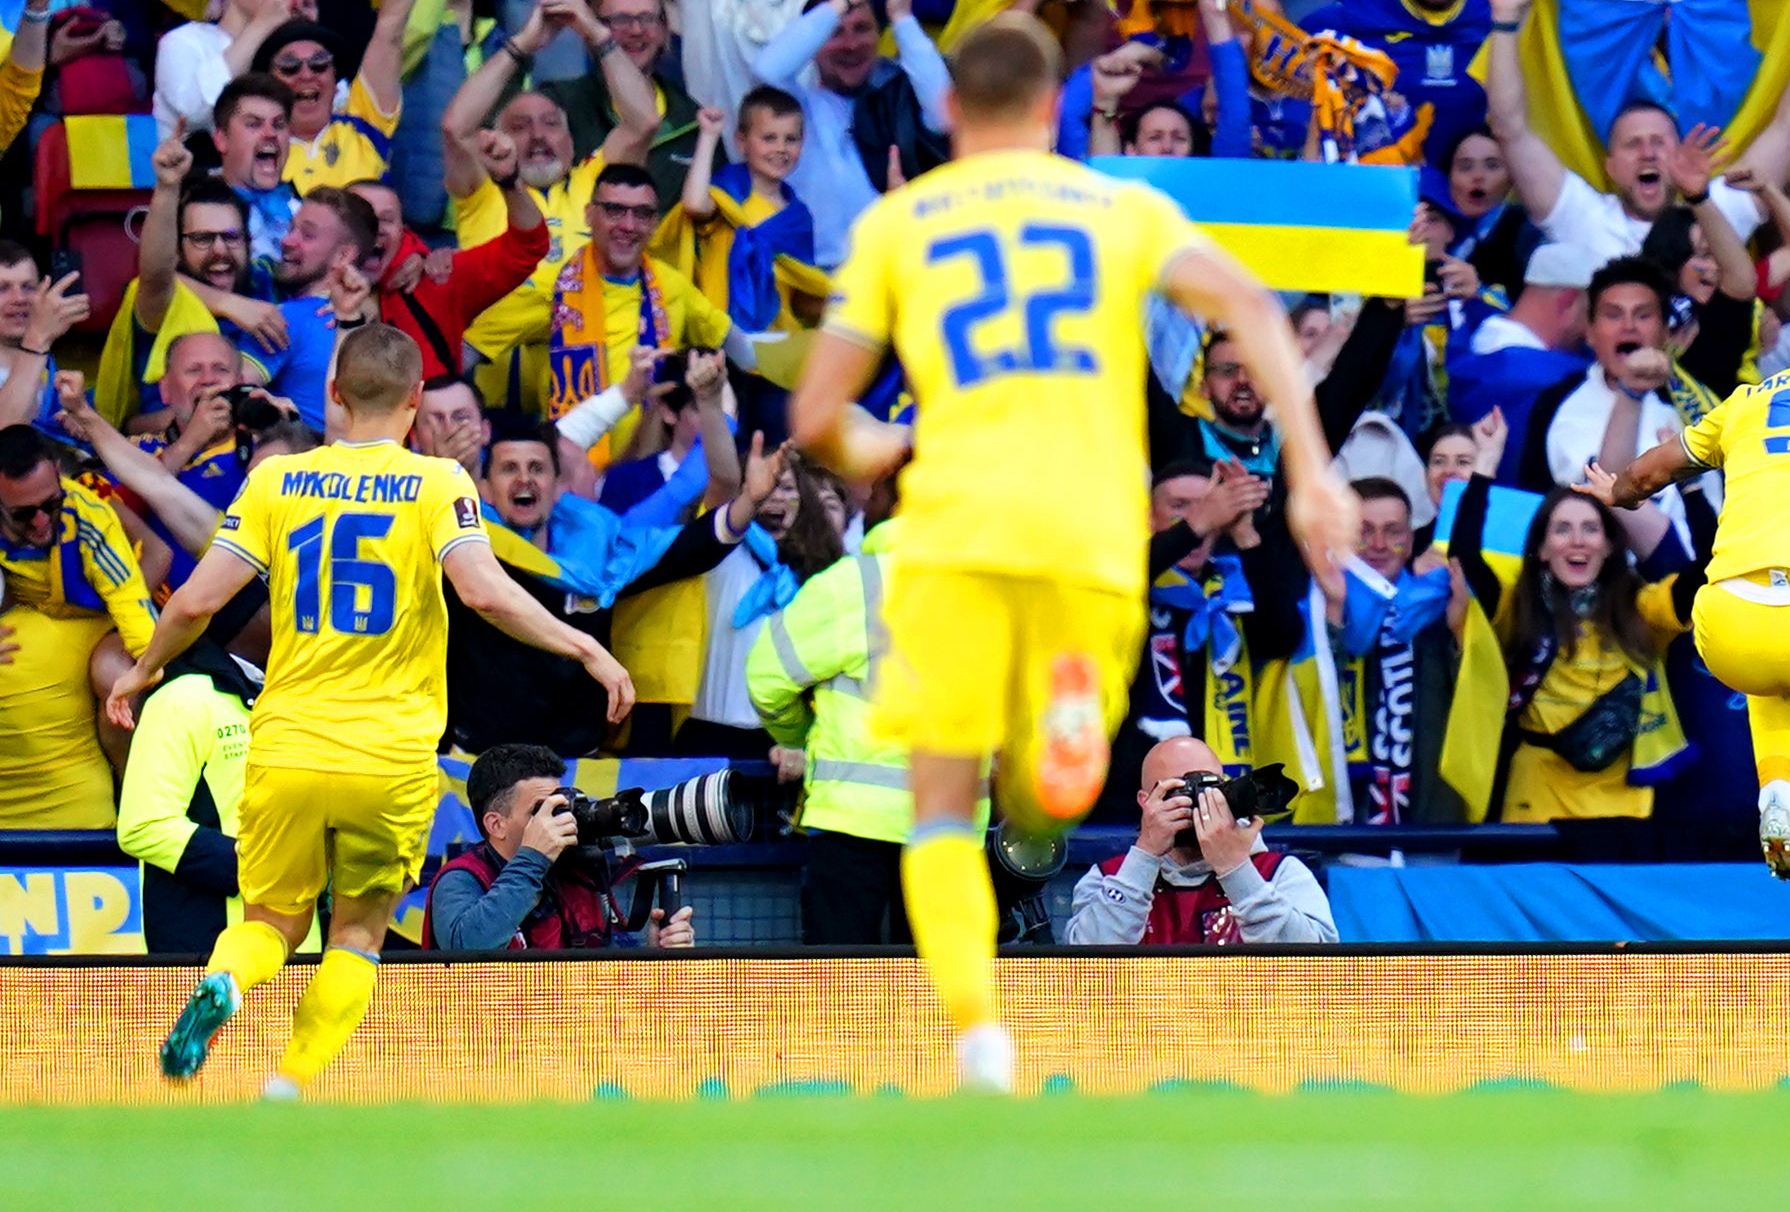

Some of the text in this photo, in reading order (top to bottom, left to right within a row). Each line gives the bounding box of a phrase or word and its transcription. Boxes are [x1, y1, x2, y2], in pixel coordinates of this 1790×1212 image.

[926, 224, 1098, 388] 22
[280, 471, 423, 503] MYKOLENKO
[287, 511, 396, 636] 16
